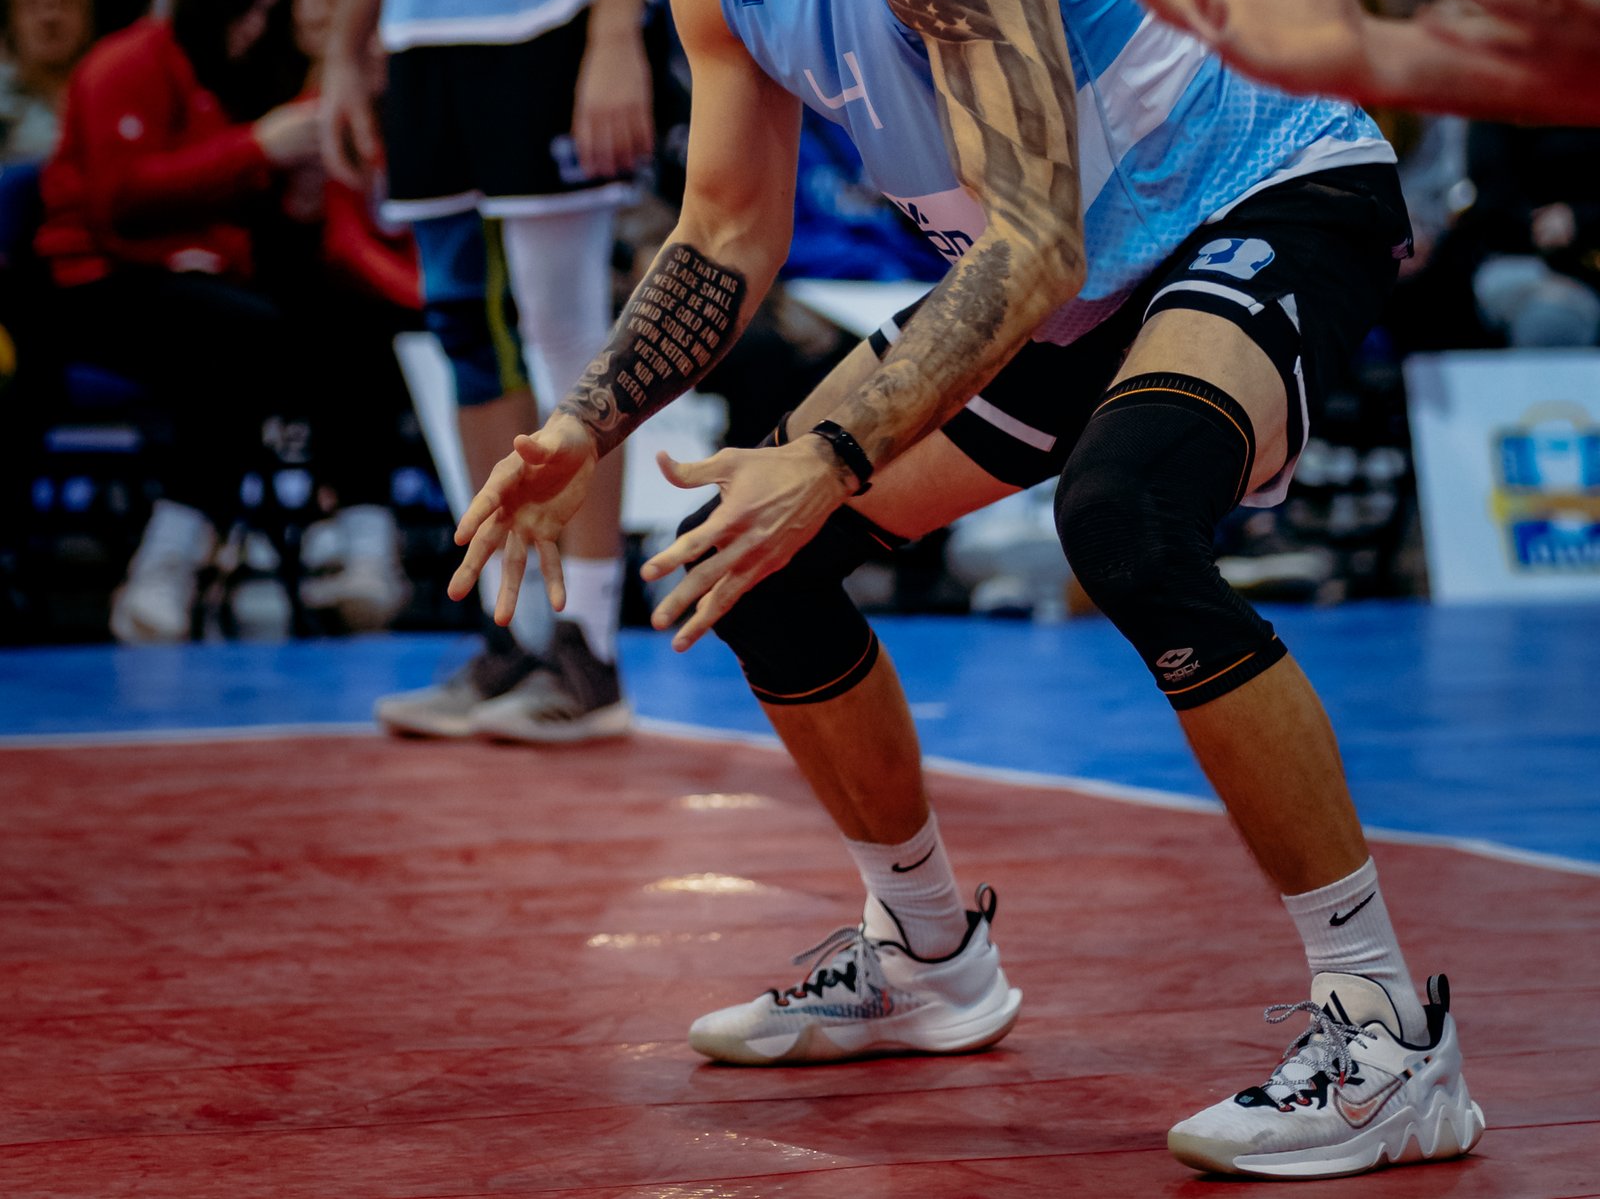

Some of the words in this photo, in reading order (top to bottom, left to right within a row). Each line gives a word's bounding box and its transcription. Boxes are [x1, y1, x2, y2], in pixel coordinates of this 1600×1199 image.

[803, 51, 884, 130] 4
[674, 248, 690, 264] SO
[693, 257, 718, 282] THAT
[720, 274, 738, 293] HIS
[652, 273, 687, 299] NEVER
[688, 293, 703, 311] BE
[704, 302, 731, 331] WITH
[700, 282, 732, 311] SHALL
[627, 317, 662, 342] KNOW
[630, 301, 662, 321] TIMID
[661, 315, 694, 348] SOULS
[691, 340, 711, 367] WHO
[641, 287, 677, 313] THOSE
[675, 305, 703, 332] COLD
[700, 326, 720, 349] AND
[633, 361, 654, 386] NOR
[634, 339, 673, 380] VICTORY
[616, 370, 647, 408] DEFEAT
[1164, 660, 1200, 681] SHOCK
